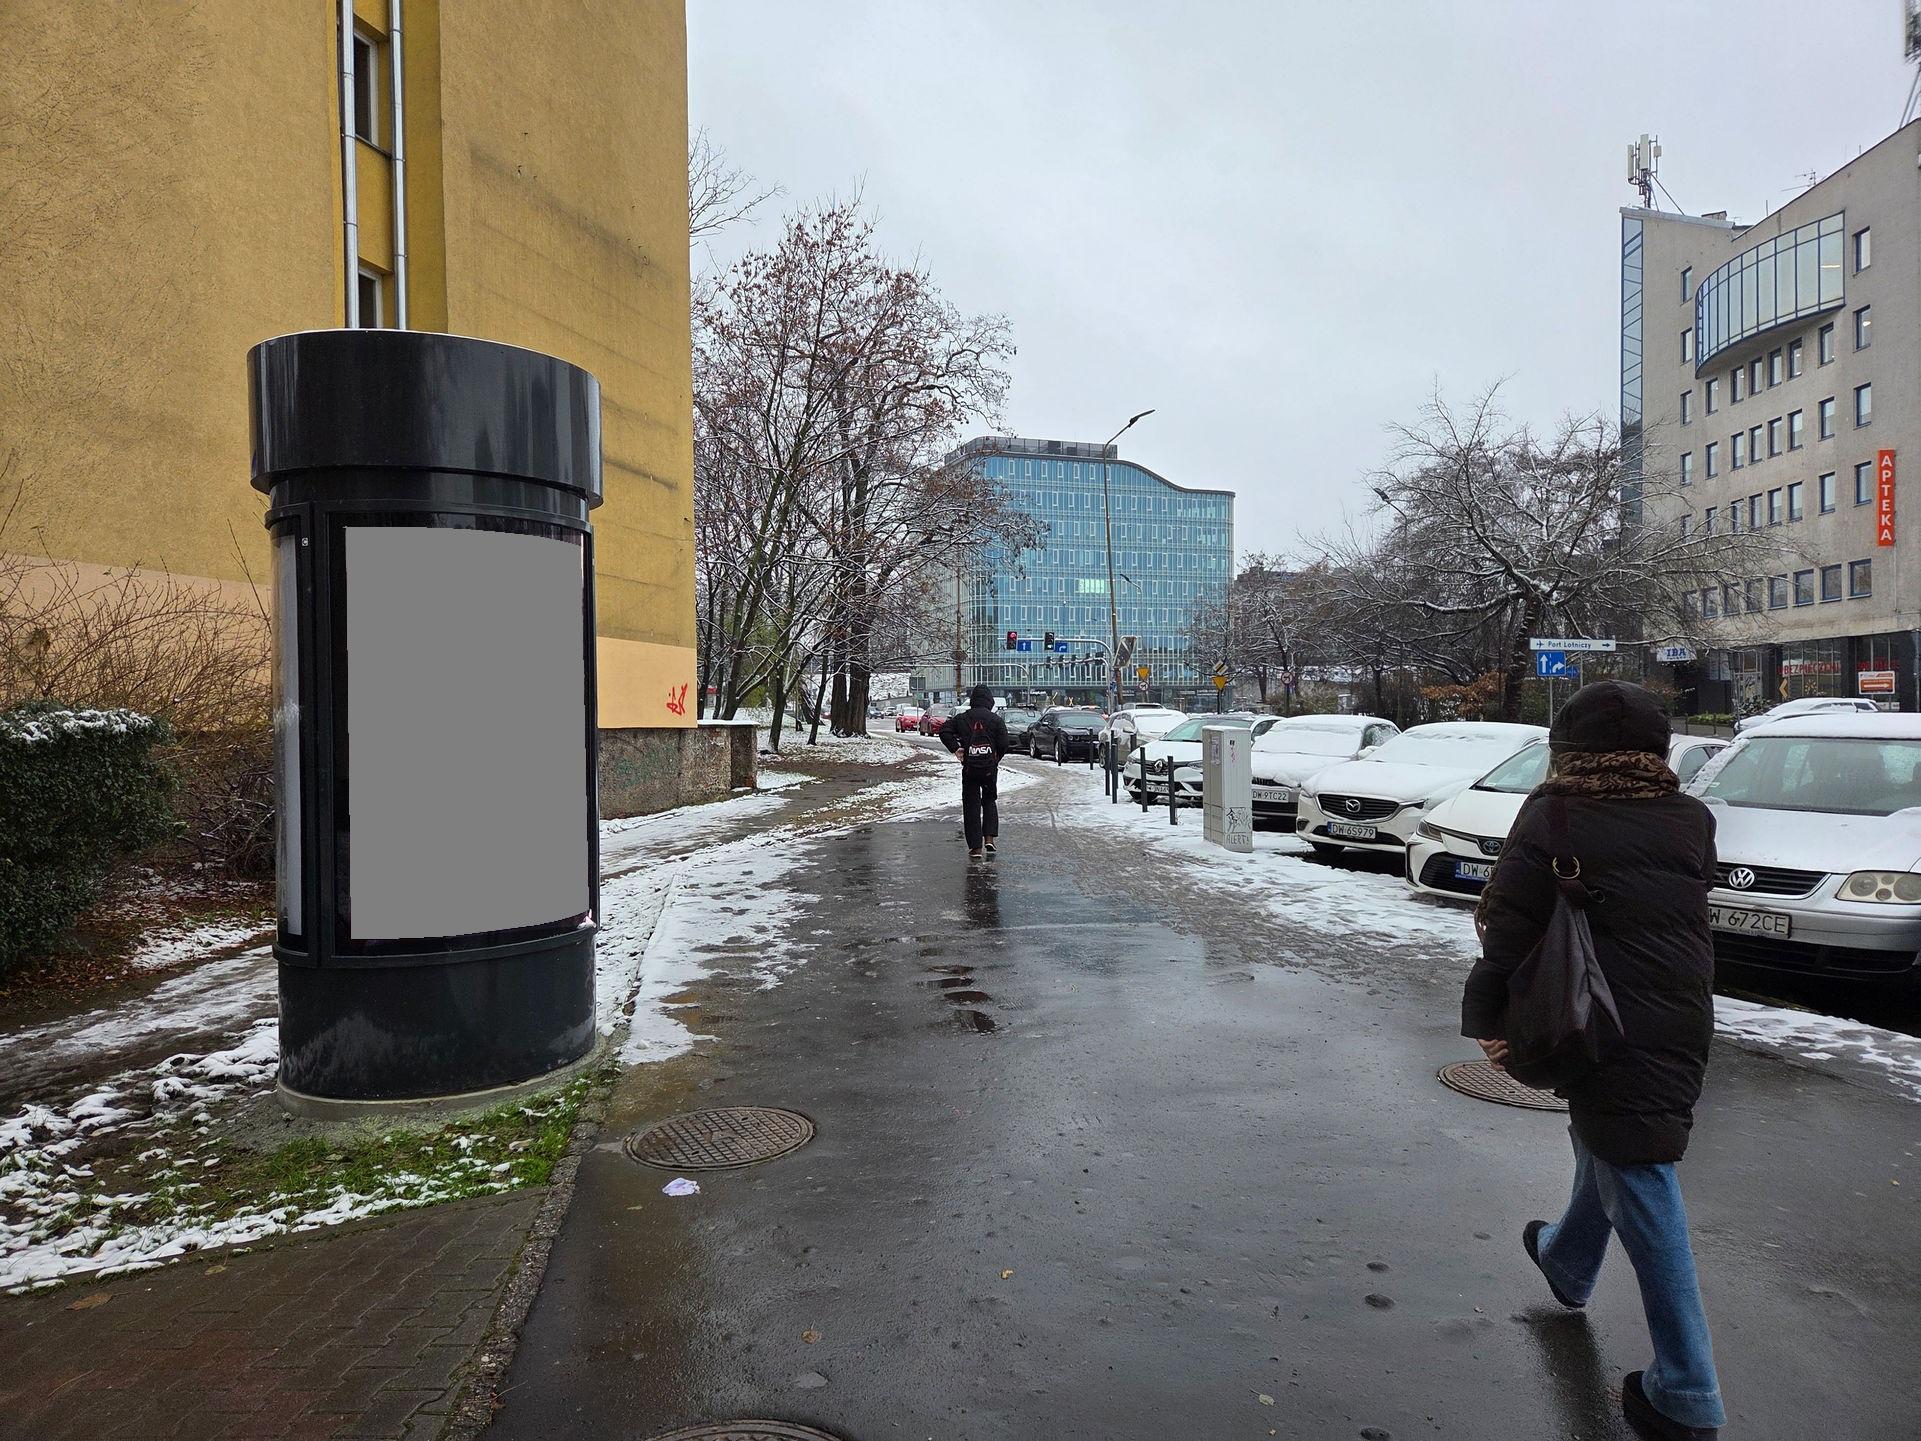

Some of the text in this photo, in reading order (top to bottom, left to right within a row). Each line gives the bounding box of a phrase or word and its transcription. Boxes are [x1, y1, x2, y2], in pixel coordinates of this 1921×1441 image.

[1880, 455, 1892, 541] APTEKA
[1547, 640, 1592, 650] Port Lotniczy
[968, 745, 993, 755] NASA
[1252, 790, 1263, 799] DW
[1332, 824, 1374, 838] DW 6S979
[1463, 863, 1479, 877] DW
[1728, 910, 1786, 934] 672CE
